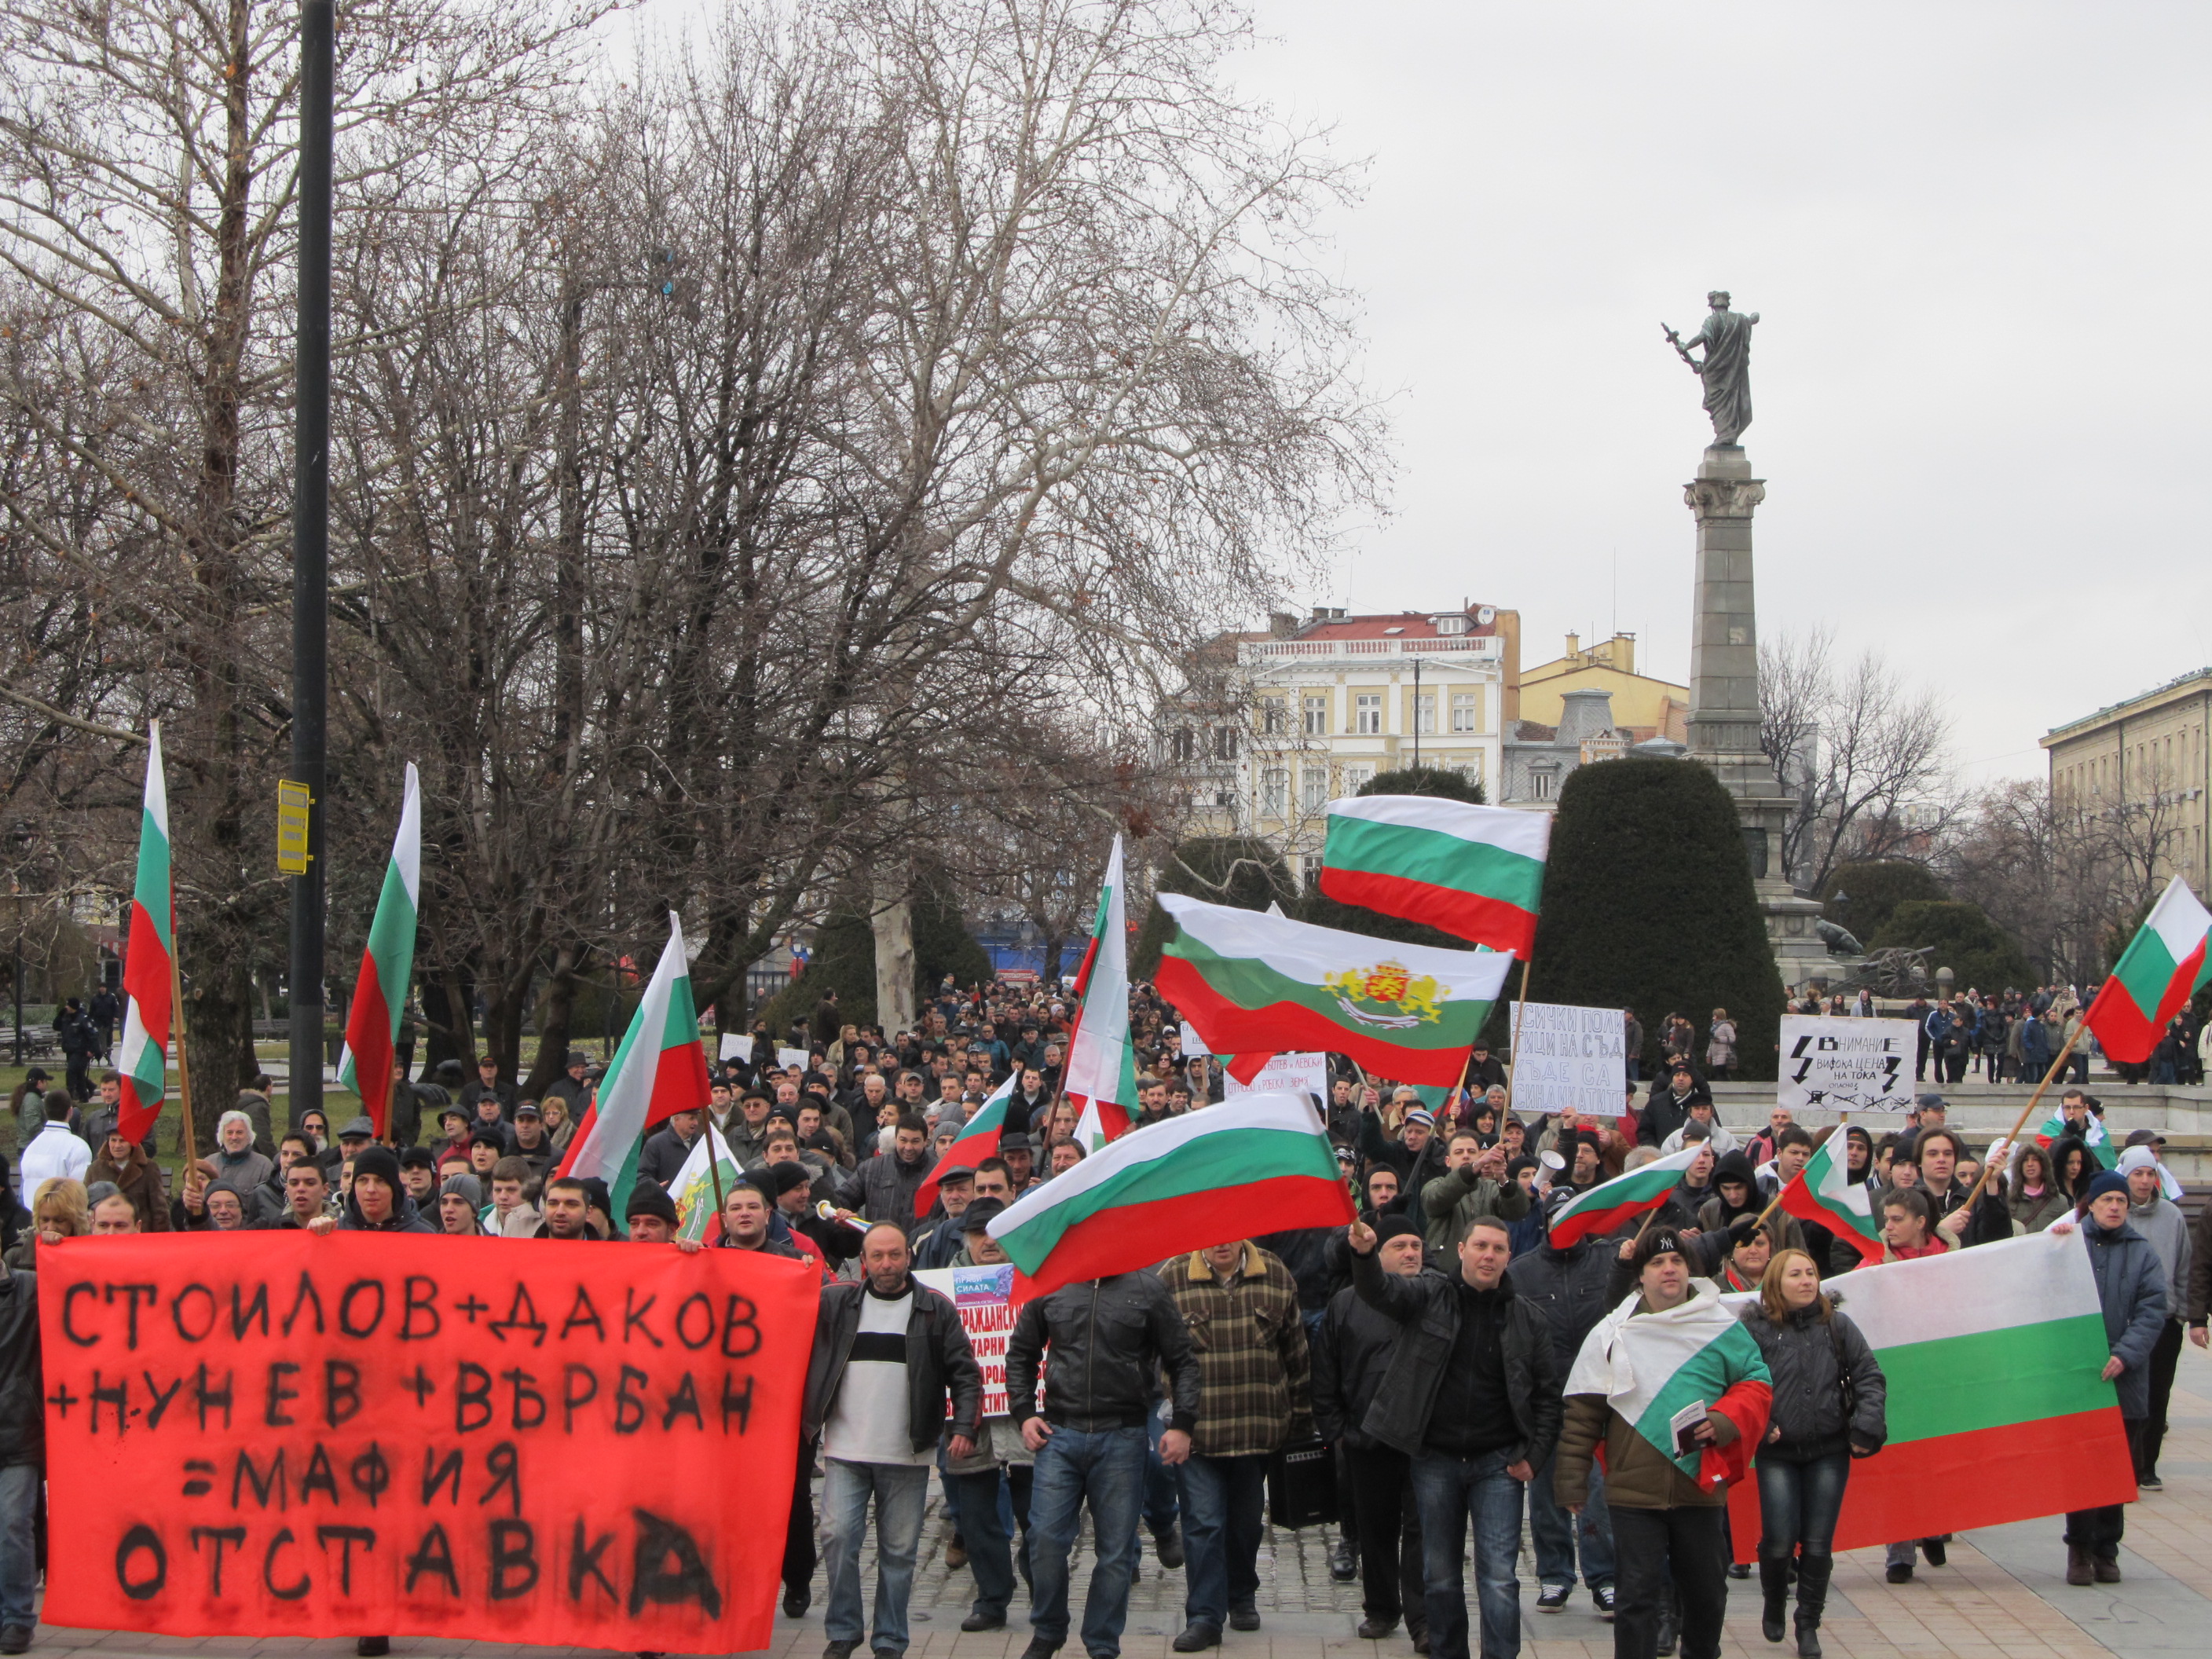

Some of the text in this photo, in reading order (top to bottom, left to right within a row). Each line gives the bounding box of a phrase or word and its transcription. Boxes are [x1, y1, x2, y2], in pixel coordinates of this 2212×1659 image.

[1511, 1003, 1625, 1035] ВСИЧКИ ПОЛИ
[1512, 1031, 1624, 1059] ТИЦИ НА СЪД
[1818, 1036, 1903, 1053] ВНИМАНИЕ
[1514, 1058, 1610, 1086] КЪДЕ СА
[1816, 1057, 1886, 1071] ВИСОКА ЦЕНА
[1834, 1071, 1877, 1080] НА ТОКА
[1512, 1083, 1626, 1113] СИНДИКАТИТЕ
[956, 1284, 990, 1293] СИЛАТА
[115, 1507, 722, 1621] ОТСТАВКА
